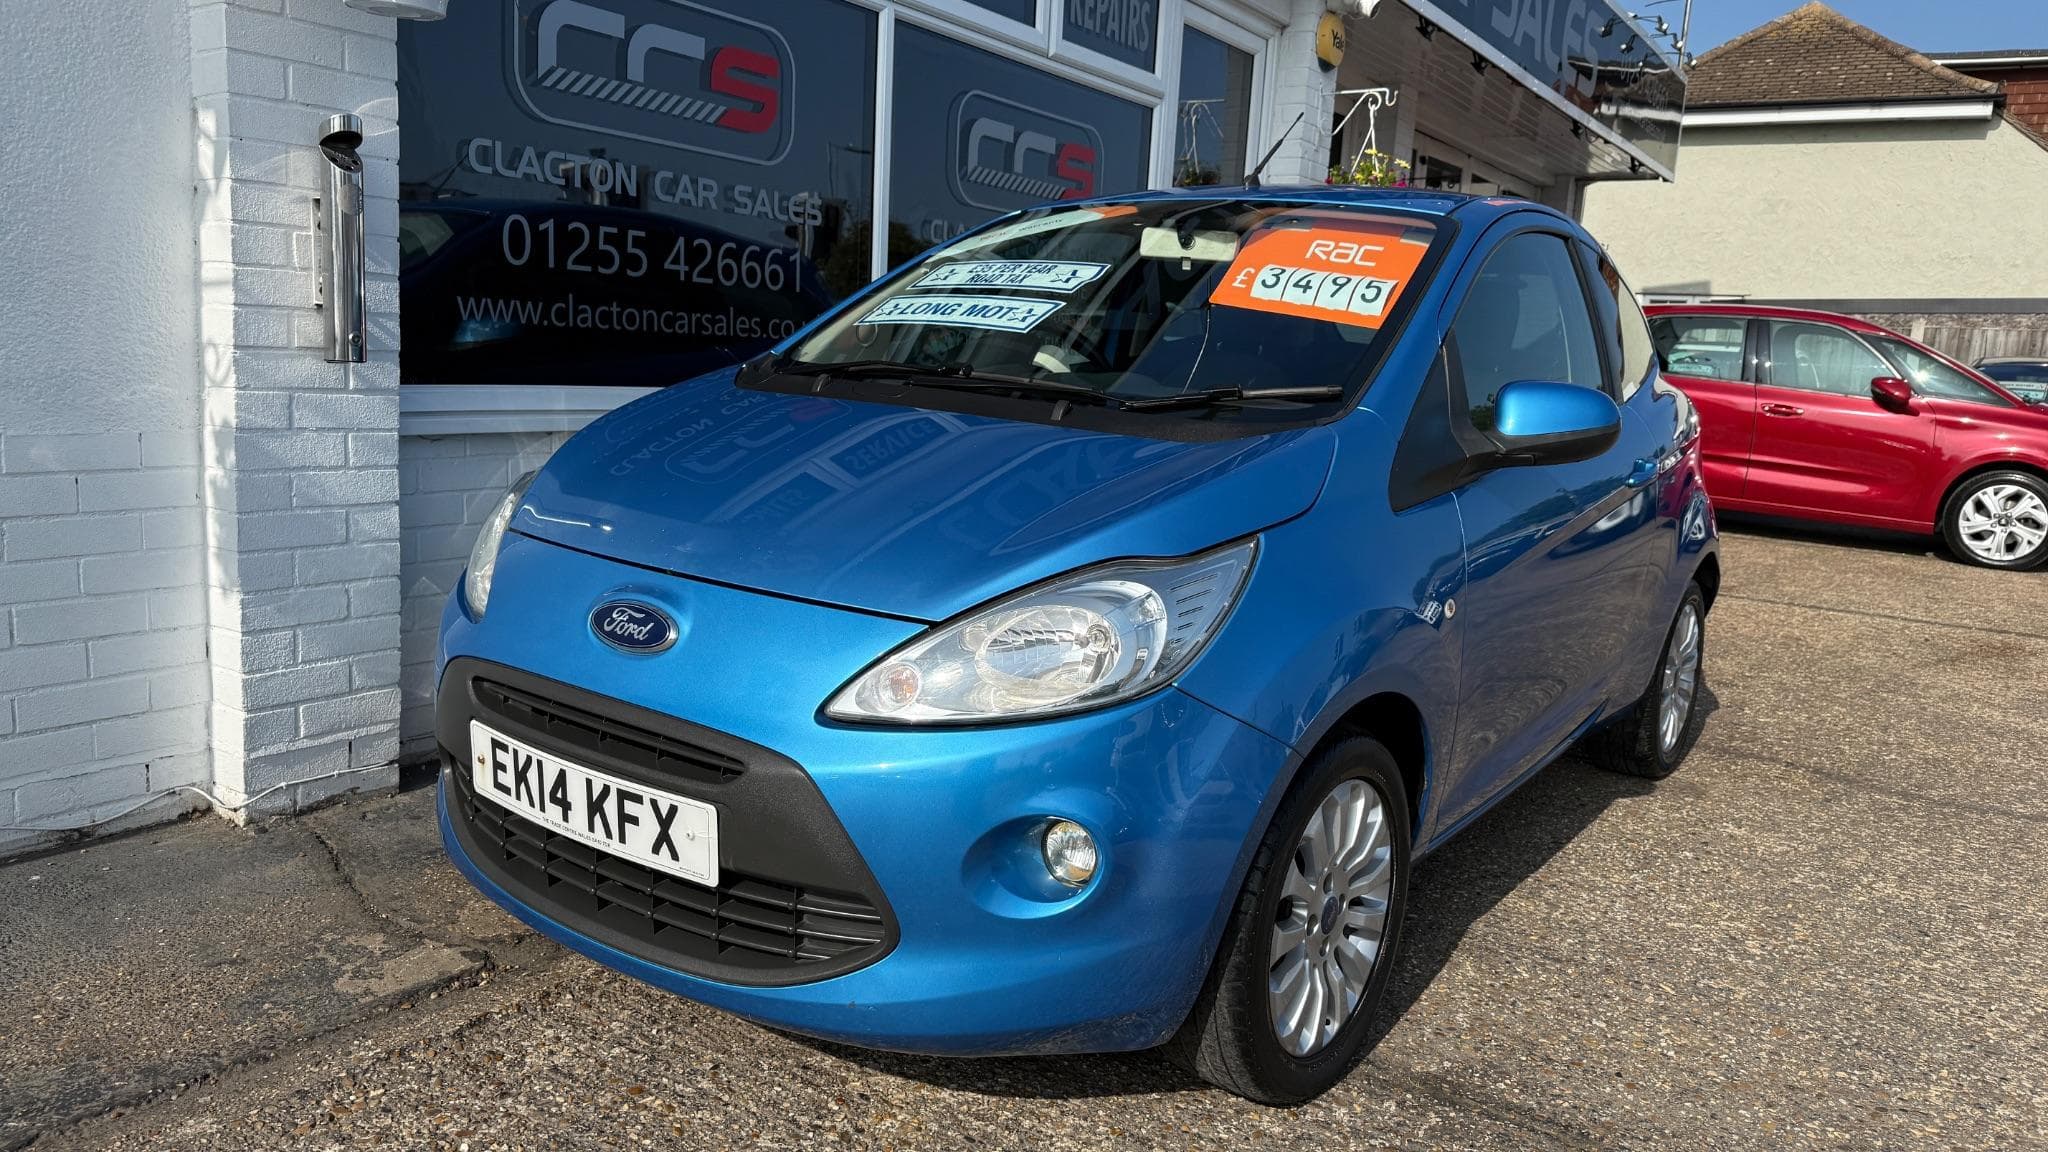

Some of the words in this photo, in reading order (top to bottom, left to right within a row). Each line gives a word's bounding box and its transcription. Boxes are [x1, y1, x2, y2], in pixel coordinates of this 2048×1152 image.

[468, 137, 638, 197] CLACTON
[654, 170, 718, 210] CAR
[734, 184, 823, 226] SALES
[502, 214, 648, 278] 01255
[663, 236, 801, 293] 426661
[992, 263, 1022, 274] PER
[1021, 263, 1058, 275] YEAR
[965, 273, 1001, 284] ROAD
[1003, 273, 1032, 284] TAX
[457, 294, 806, 340] www.clactoncarsales.co
[899, 302, 960, 318] LONG
[960, 303, 1022, 320] MOT
[603, 606, 654, 642] Ford
[490, 736, 572, 824] EK14
[585, 776, 681, 862] KFX
